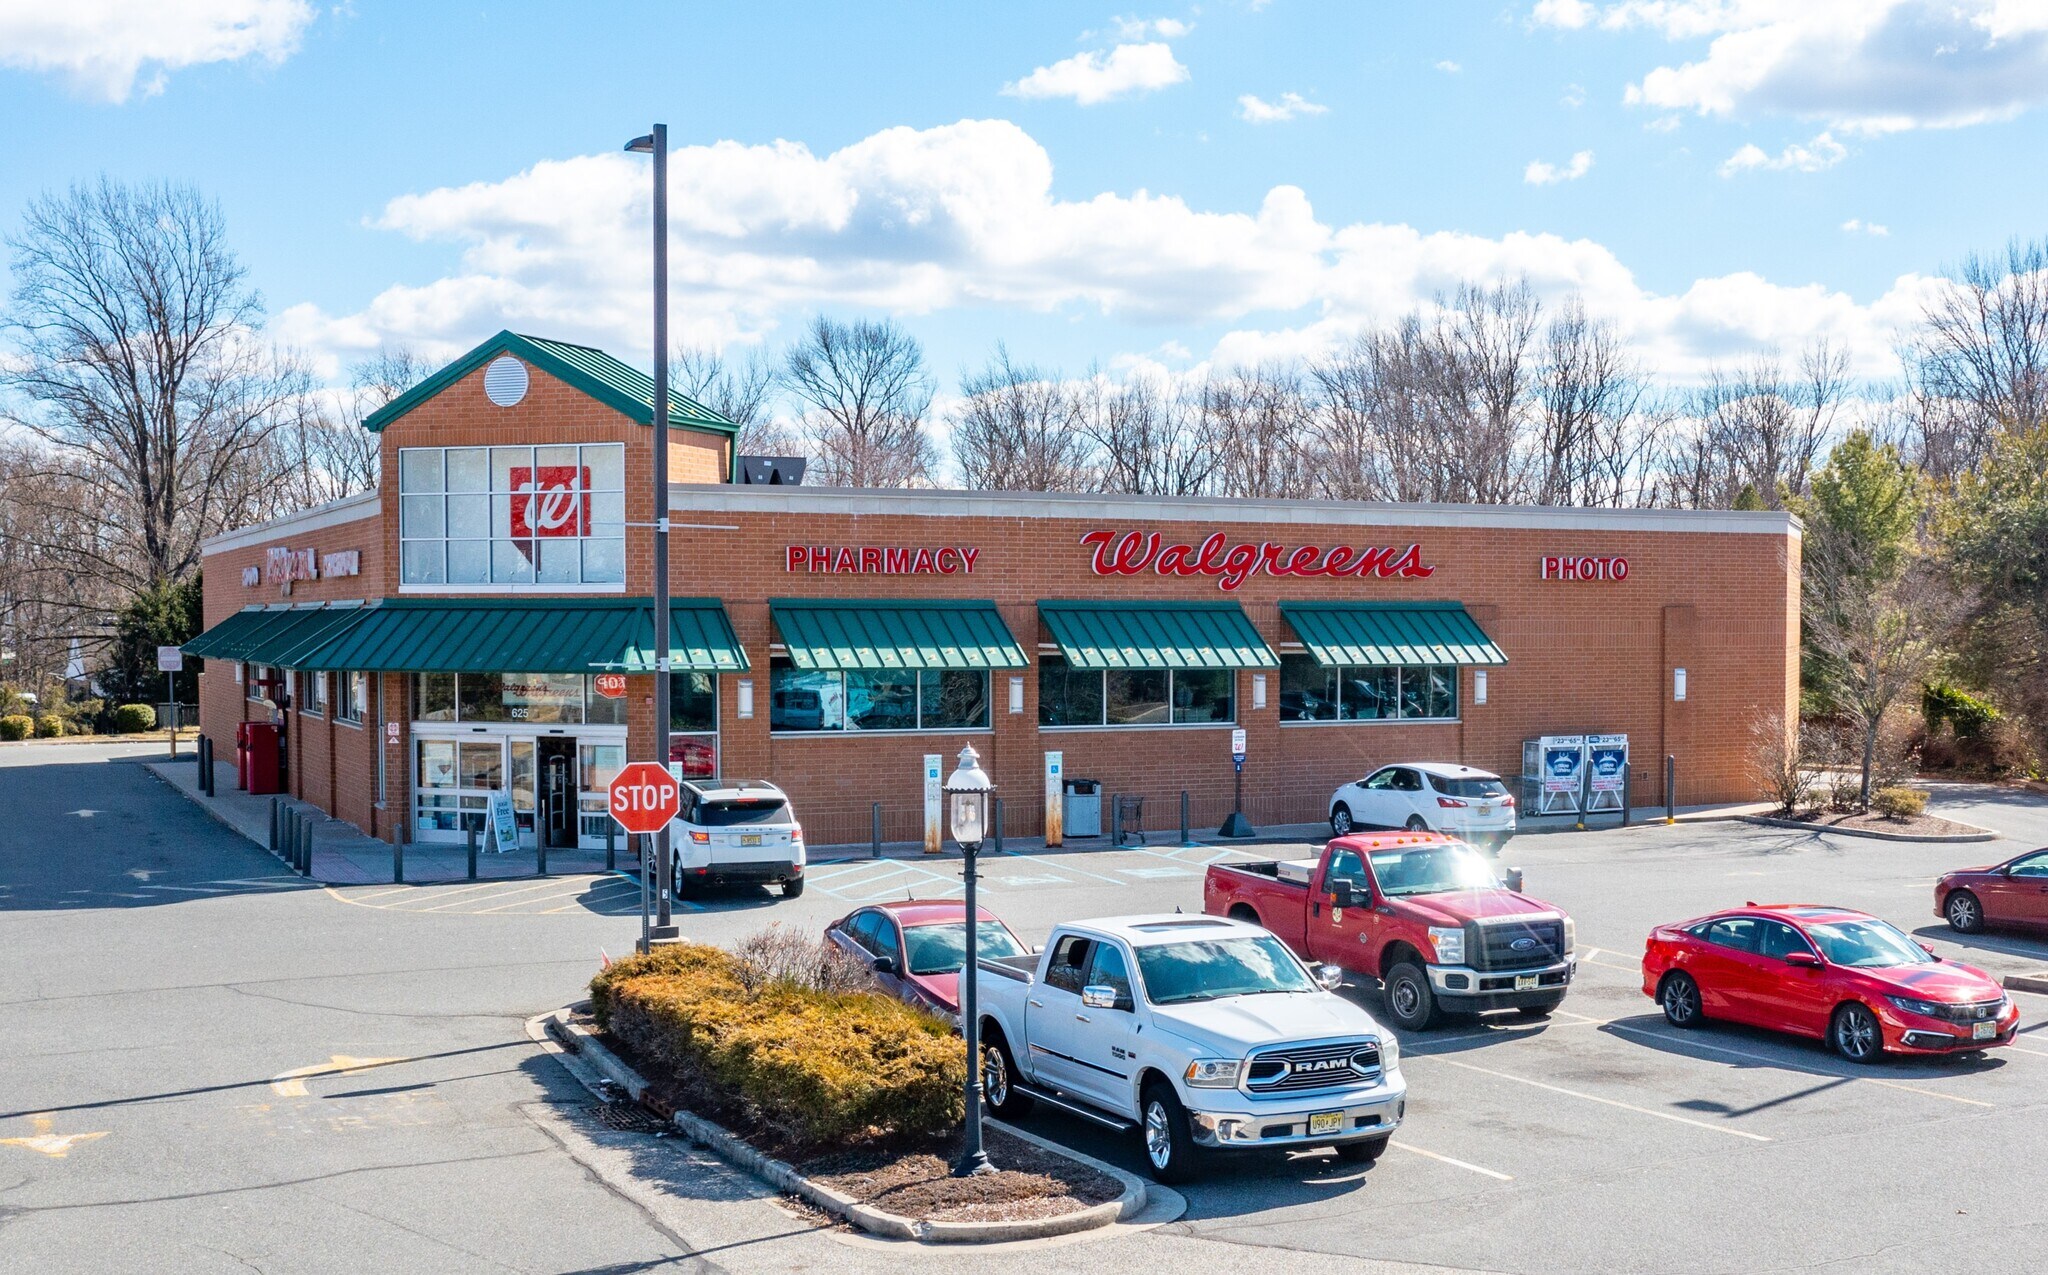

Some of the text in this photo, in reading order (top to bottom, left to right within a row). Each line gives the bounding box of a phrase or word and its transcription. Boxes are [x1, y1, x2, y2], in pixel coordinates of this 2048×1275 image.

[786, 546, 980, 574] PHARMACY
[1080, 530, 1435, 592] Walgreens
[1541, 557, 1629, 581] PHOTO
[511, 708, 529, 718] 625
[614, 784, 675, 812] STOP
[1295, 1058, 1348, 1072] RAM
